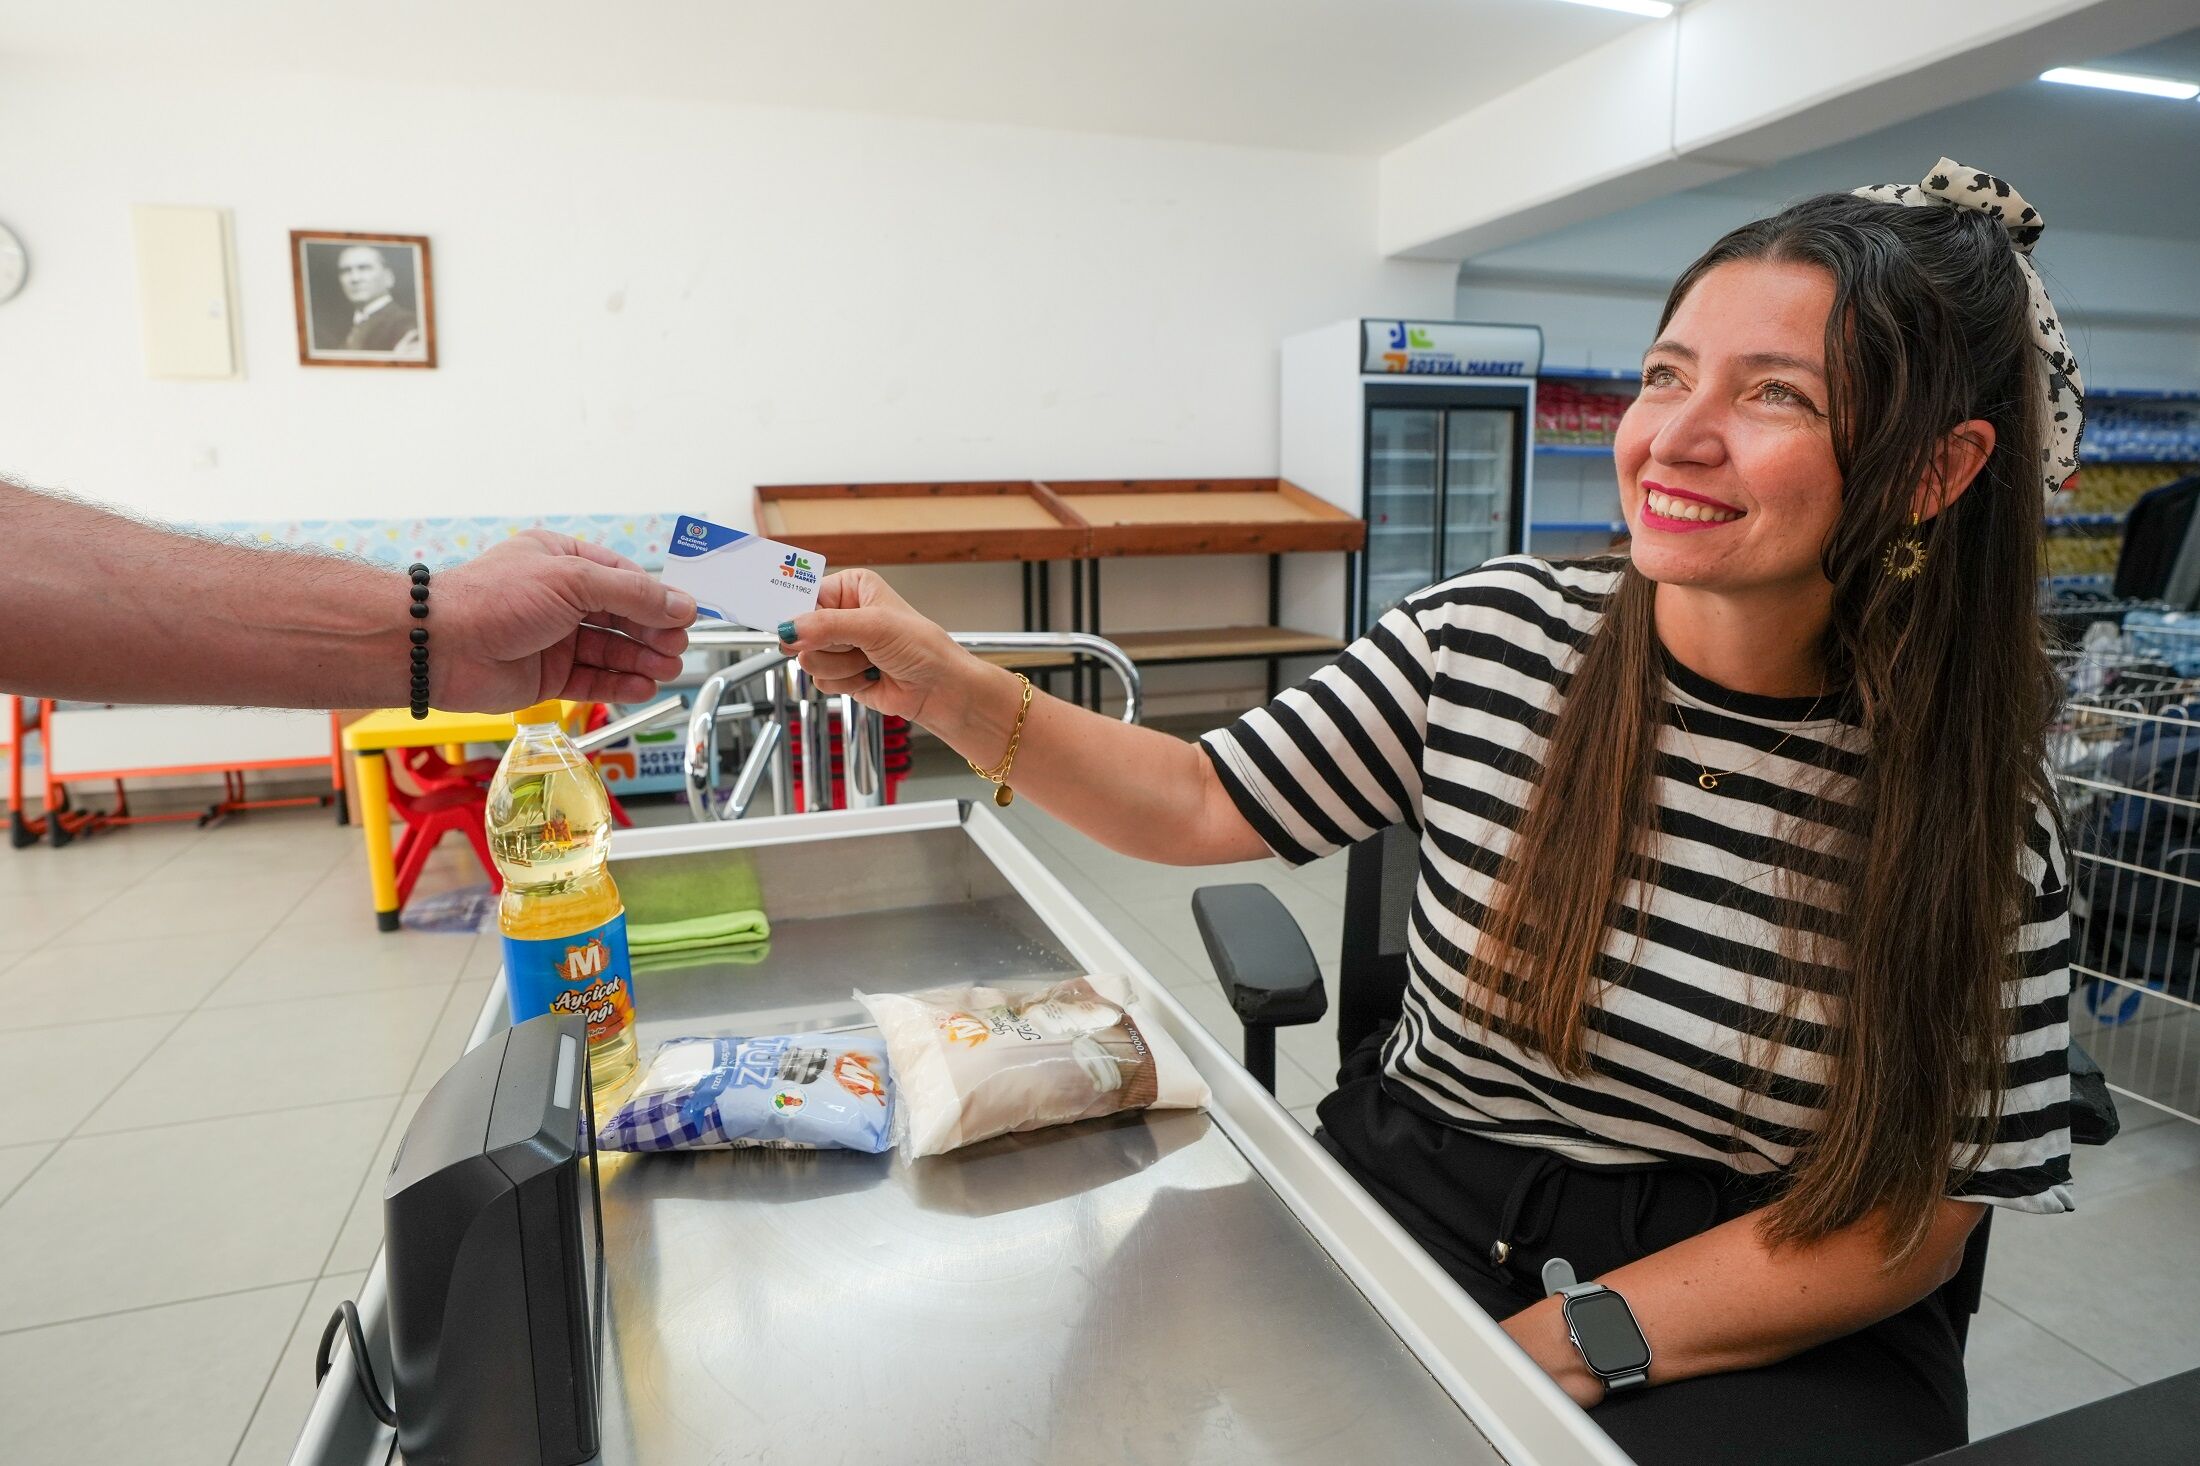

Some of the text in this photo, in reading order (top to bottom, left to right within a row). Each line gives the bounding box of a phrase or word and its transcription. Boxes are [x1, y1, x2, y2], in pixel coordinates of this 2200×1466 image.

[1466, 360, 1524, 377] MARKET
[677, 539, 709, 552] Belediyesi
[680, 535, 708, 547] Gaziemir
[794, 574, 817, 584] MARKET
[795, 569, 817, 581] SOSYAL
[769, 578, 812, 595] 4016311962
[568, 945, 601, 979] M
[554, 975, 621, 1011] Ayçiçek
[734, 1039, 786, 1087] TUZ
